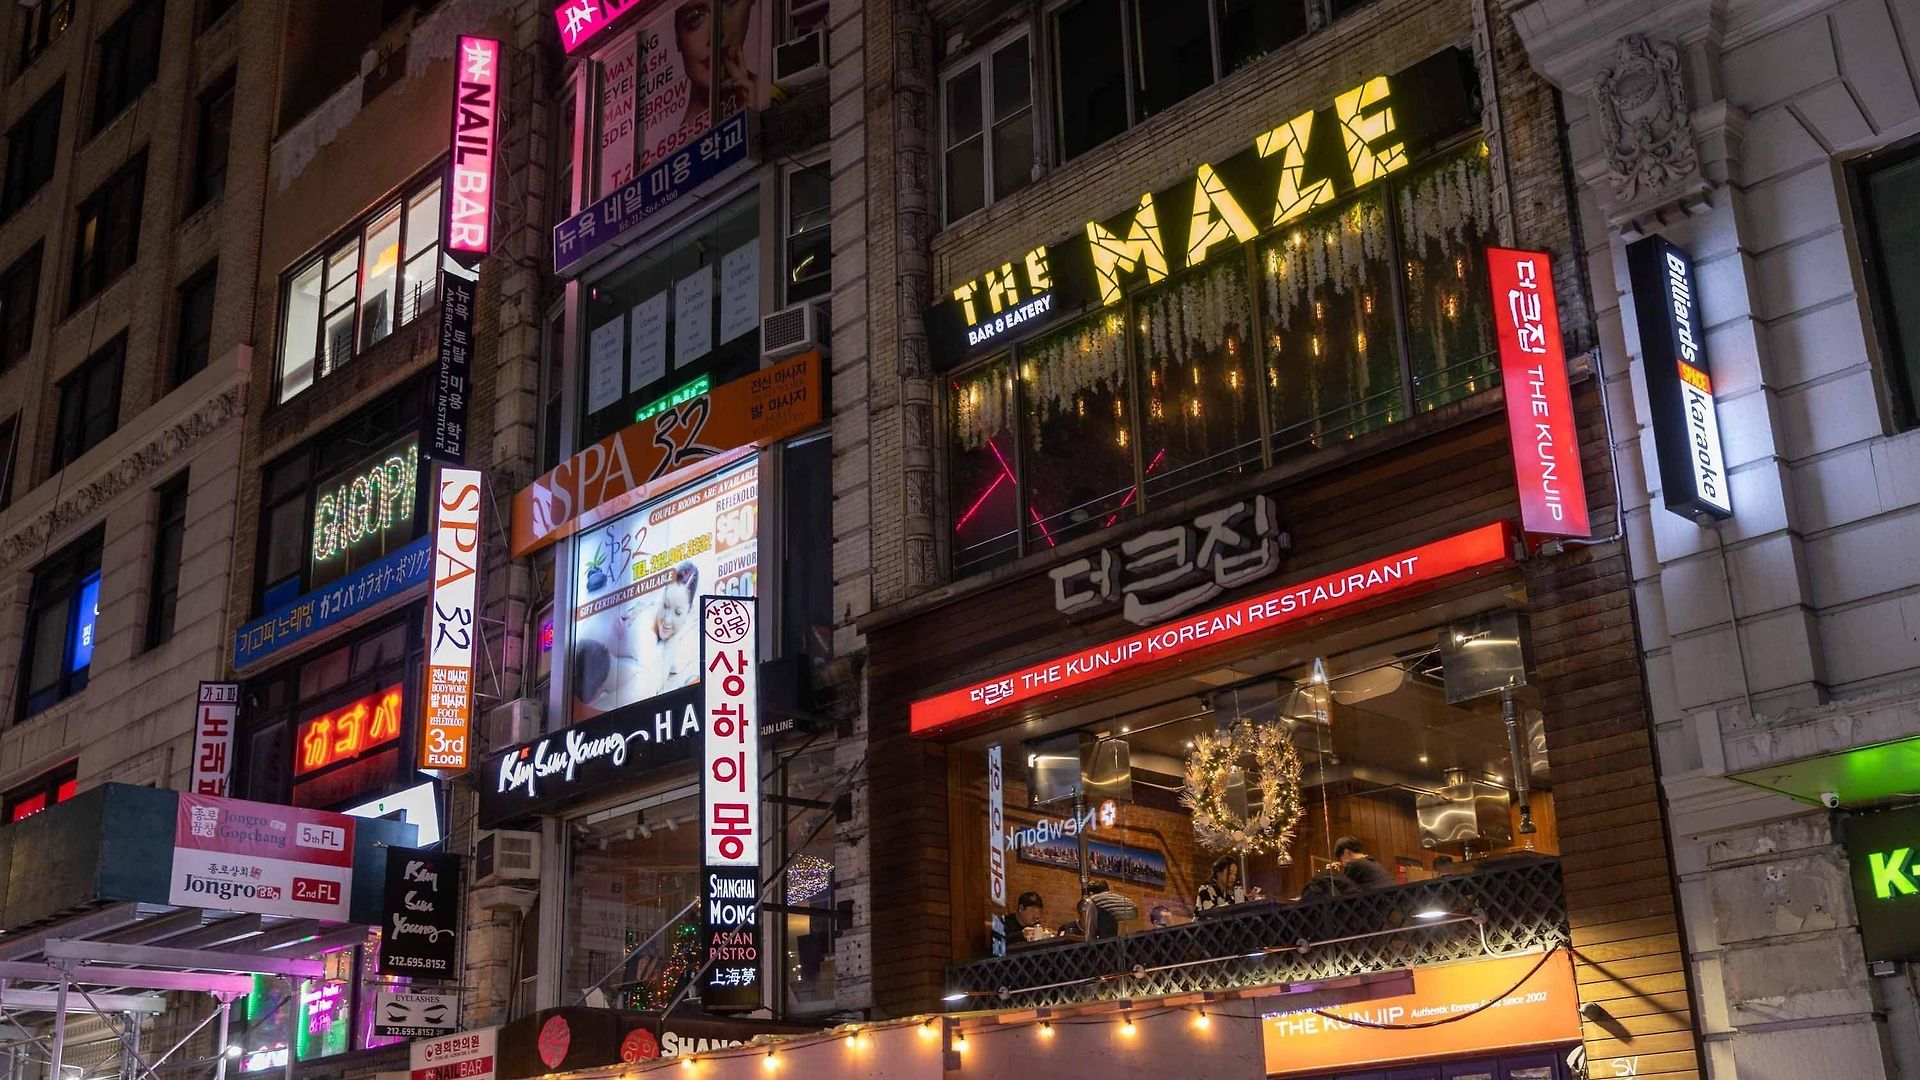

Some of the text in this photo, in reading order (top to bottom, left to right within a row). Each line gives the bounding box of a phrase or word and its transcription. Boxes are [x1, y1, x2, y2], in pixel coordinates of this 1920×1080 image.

[456, 81, 491, 165] NAIL
[645, 97, 686, 130] TATTOO
[559, 118, 743, 254] 뉴욕 네일 미용 학교
[450, 169, 487, 248] BAR
[953, 76, 1408, 327] THE MAZE
[968, 294, 1052, 346] BAR & EATERY
[1508, 259, 1546, 354] 더큰집
[1666, 252, 1698, 363] Billiards
[435, 287, 454, 449] AMERICAN BEAUTY INSTITUTE
[775, 361, 807, 383] 마사지
[768, 387, 807, 411] 마사지
[1528, 365, 1563, 521] THE KUNJIP
[1688, 388, 1718, 499] Karaoke
[550, 431, 636, 529] SPA
[650, 393, 720, 483] 32
[651, 469, 758, 523] COUPLE ROOMS ARE AVAILABLE
[434, 481, 480, 654] SPA 32
[1047, 494, 1281, 628] 더큰집
[580, 571, 674, 618] GIFT CERTIFICATE AVAILABLE
[970, 556, 1420, 706] 더큰집 THE KUNJIP KOREAN RESTAURANT
[431, 684, 466, 694] BODYWORK
[437, 709, 459, 718] FOOT
[775, 718, 795, 732] LINE
[428, 728, 464, 753] 3rd
[709, 649, 752, 859] 상하이몽
[428, 754, 463, 765] FLOOR
[498, 747, 535, 797] Kim
[534, 740, 568, 777] Sun
[565, 730, 649, 782] Young
[222, 809, 268, 828] Jongro
[220, 827, 287, 848] Gopchang
[303, 827, 339, 847] 5th FL
[184, 873, 256, 900] Jongro
[403, 860, 438, 892] Kim
[709, 873, 755, 899] SHANGHAI
[296, 881, 336, 901] 2nd FL
[404, 890, 435, 912] Sun
[710, 900, 755, 925] MONG
[391, 912, 455, 943] Young
[712, 932, 753, 945] ASIAN
[389, 955, 446, 970] 212.695.8152
[709, 947, 757, 961] BISTRO
[395, 994, 440, 1004] EYELASHES
[1525, 991, 1548, 1003] 2002
[1275, 1006, 1404, 1039] THE KUNJIP
[1411, 1005, 1449, 1019] Authentic
[386, 1026, 435, 1037] 212.695.8152
[460, 1060, 483, 1078] BAR
